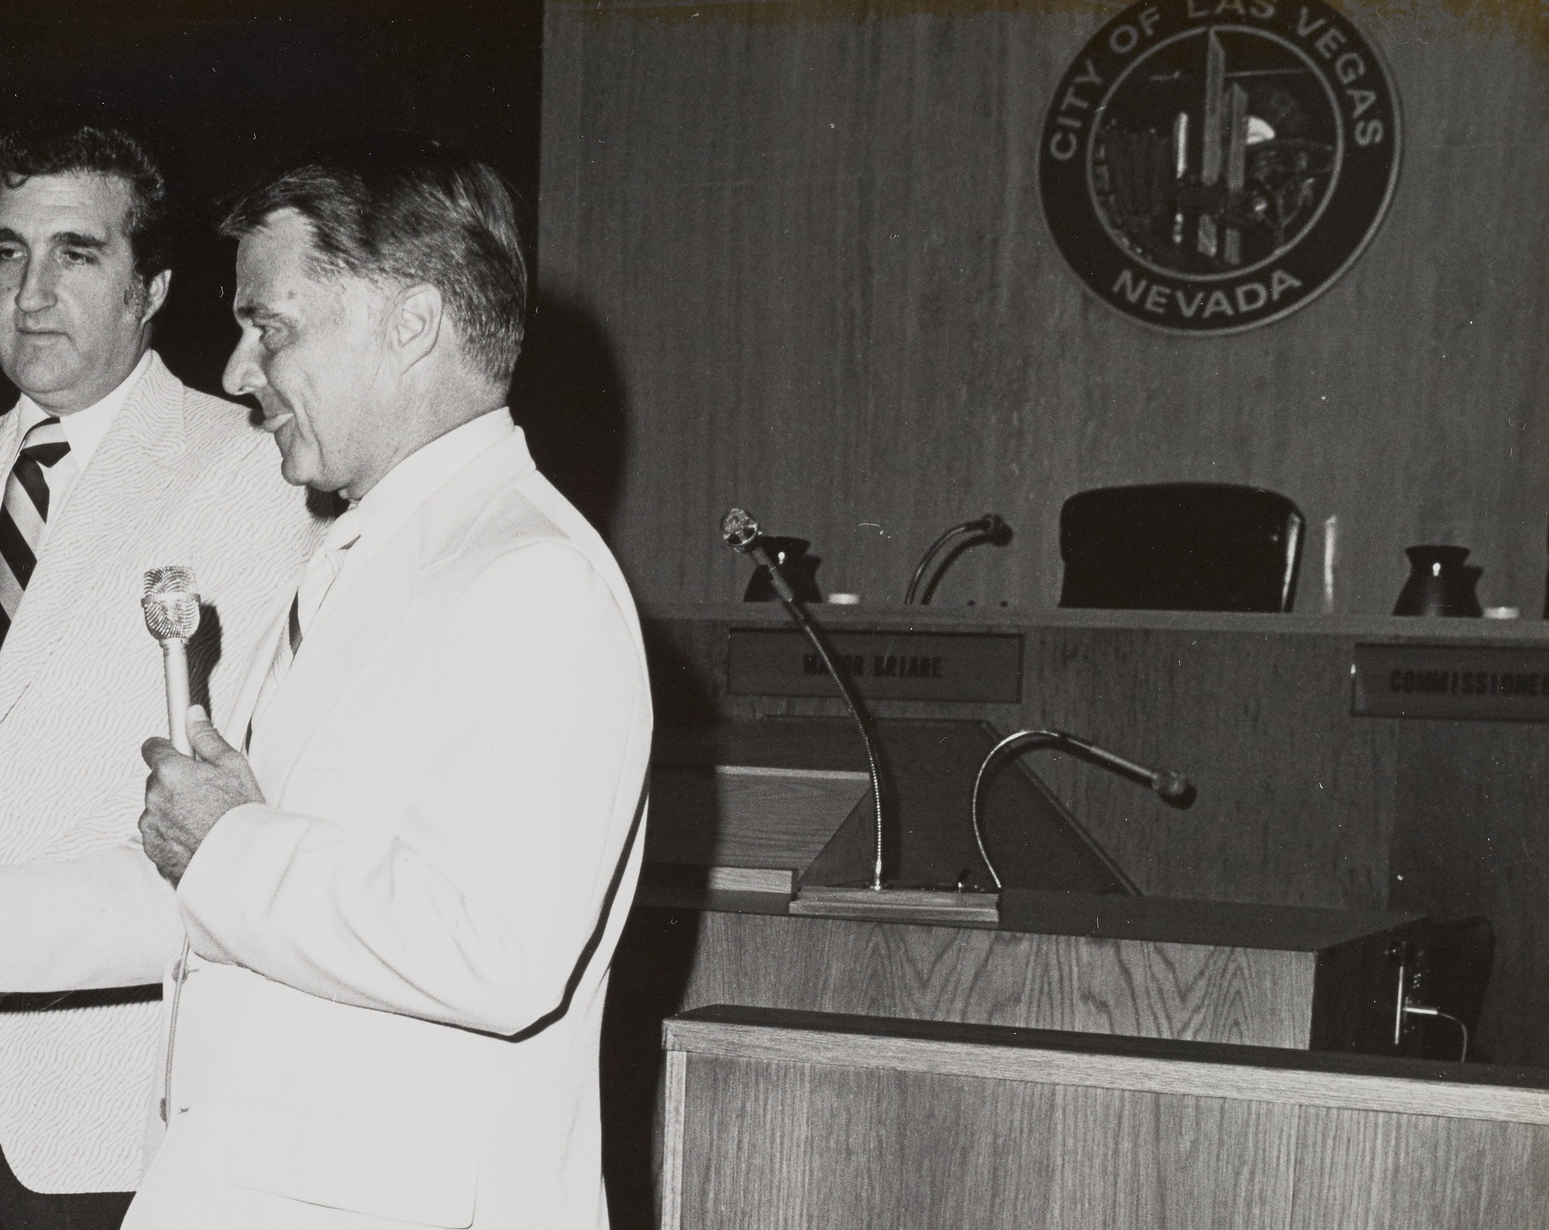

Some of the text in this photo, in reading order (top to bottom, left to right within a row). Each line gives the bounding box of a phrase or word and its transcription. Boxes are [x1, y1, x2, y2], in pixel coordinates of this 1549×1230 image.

[1051, 58, 1102, 160] CITY
[1109, 8, 1160, 53] OF
[1296, 8, 1384, 147] VEGAS
[1112, 269, 1302, 318] NEVADA
